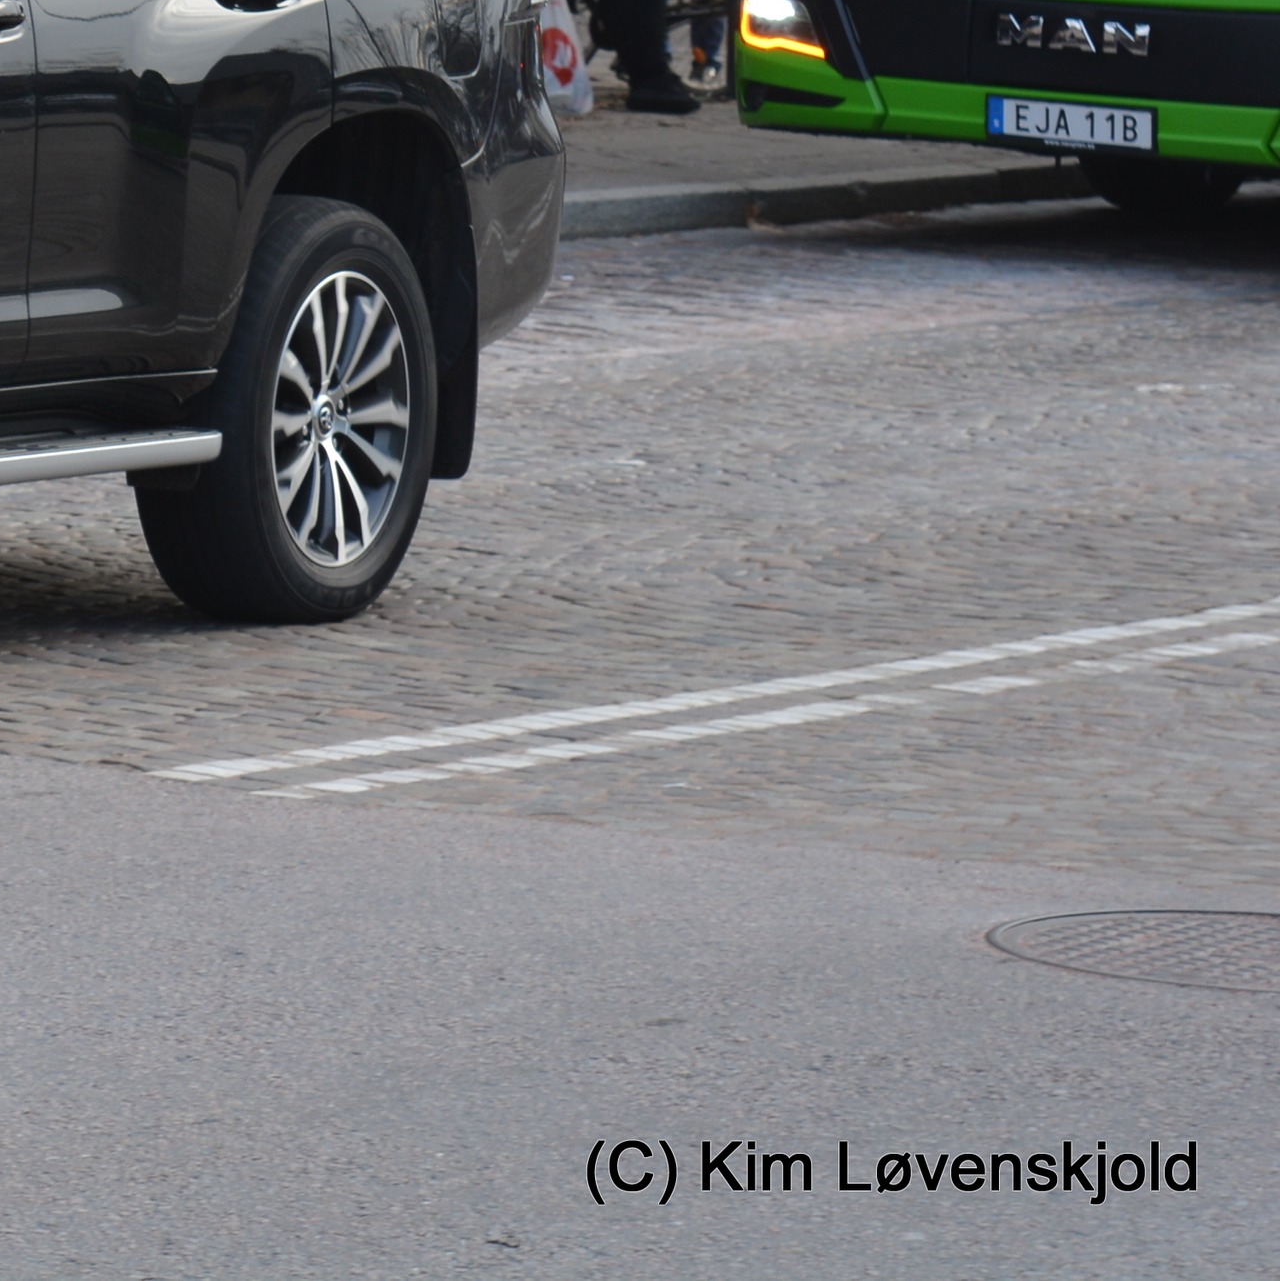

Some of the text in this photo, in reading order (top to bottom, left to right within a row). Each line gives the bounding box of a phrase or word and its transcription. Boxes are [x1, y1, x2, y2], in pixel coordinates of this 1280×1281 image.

[997, 13, 1151, 57] MAN
[1015, 102, 1139, 144] EJA 11B
